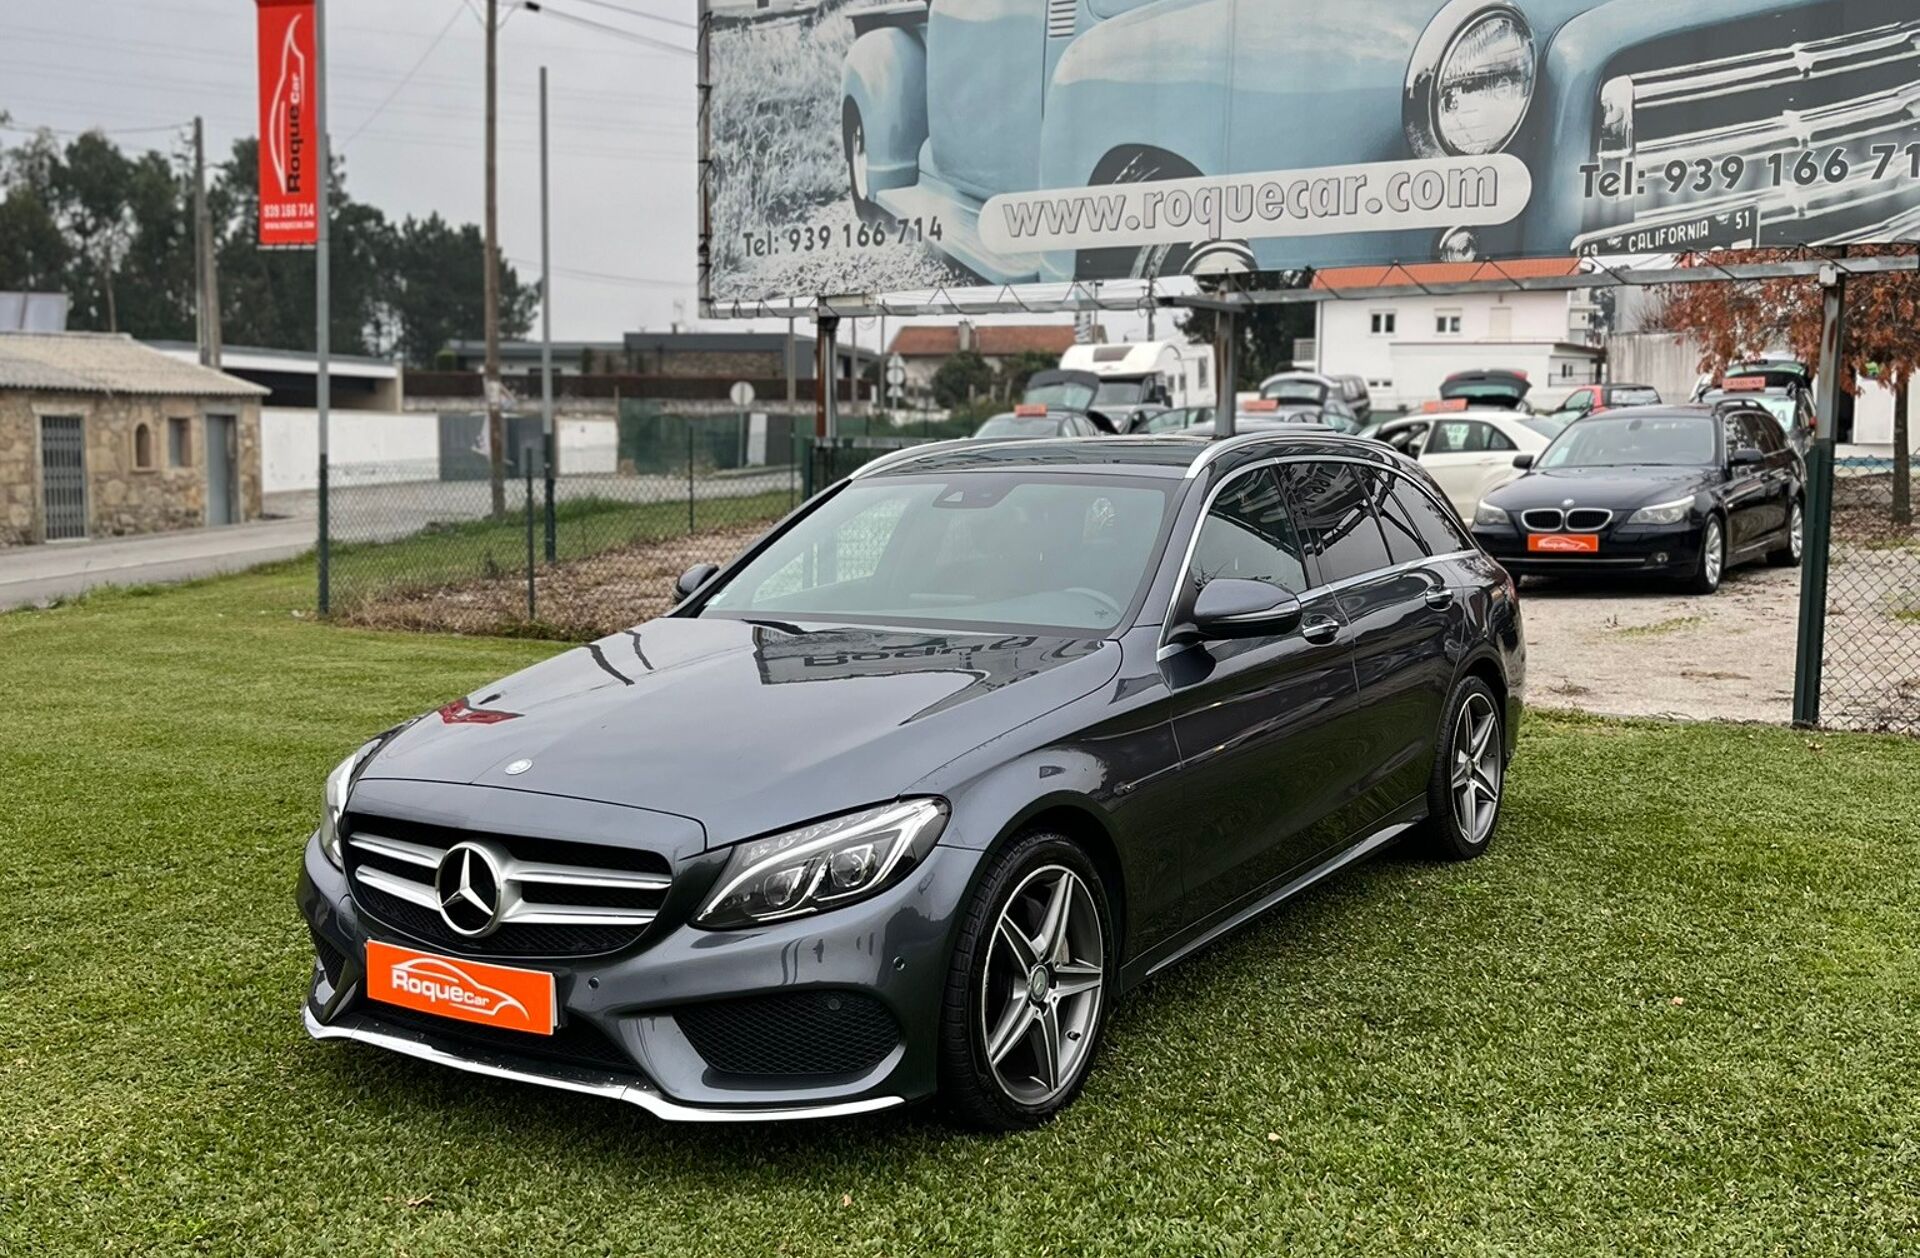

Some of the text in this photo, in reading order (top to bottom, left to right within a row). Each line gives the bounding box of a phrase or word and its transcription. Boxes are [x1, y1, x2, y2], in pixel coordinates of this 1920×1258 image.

[1579, 161, 1645, 198] Tel:
[1664, 155, 1745, 194] 939
[1767, 146, 1849, 187] 166
[298, 202, 315, 217] 714
[1002, 166, 1498, 240] www.roquecar.com
[742, 216, 943, 257] Tel: 939 166 714
[1628, 220, 1709, 252] CALIFORNIA
[1735, 210, 1750, 230] 51
